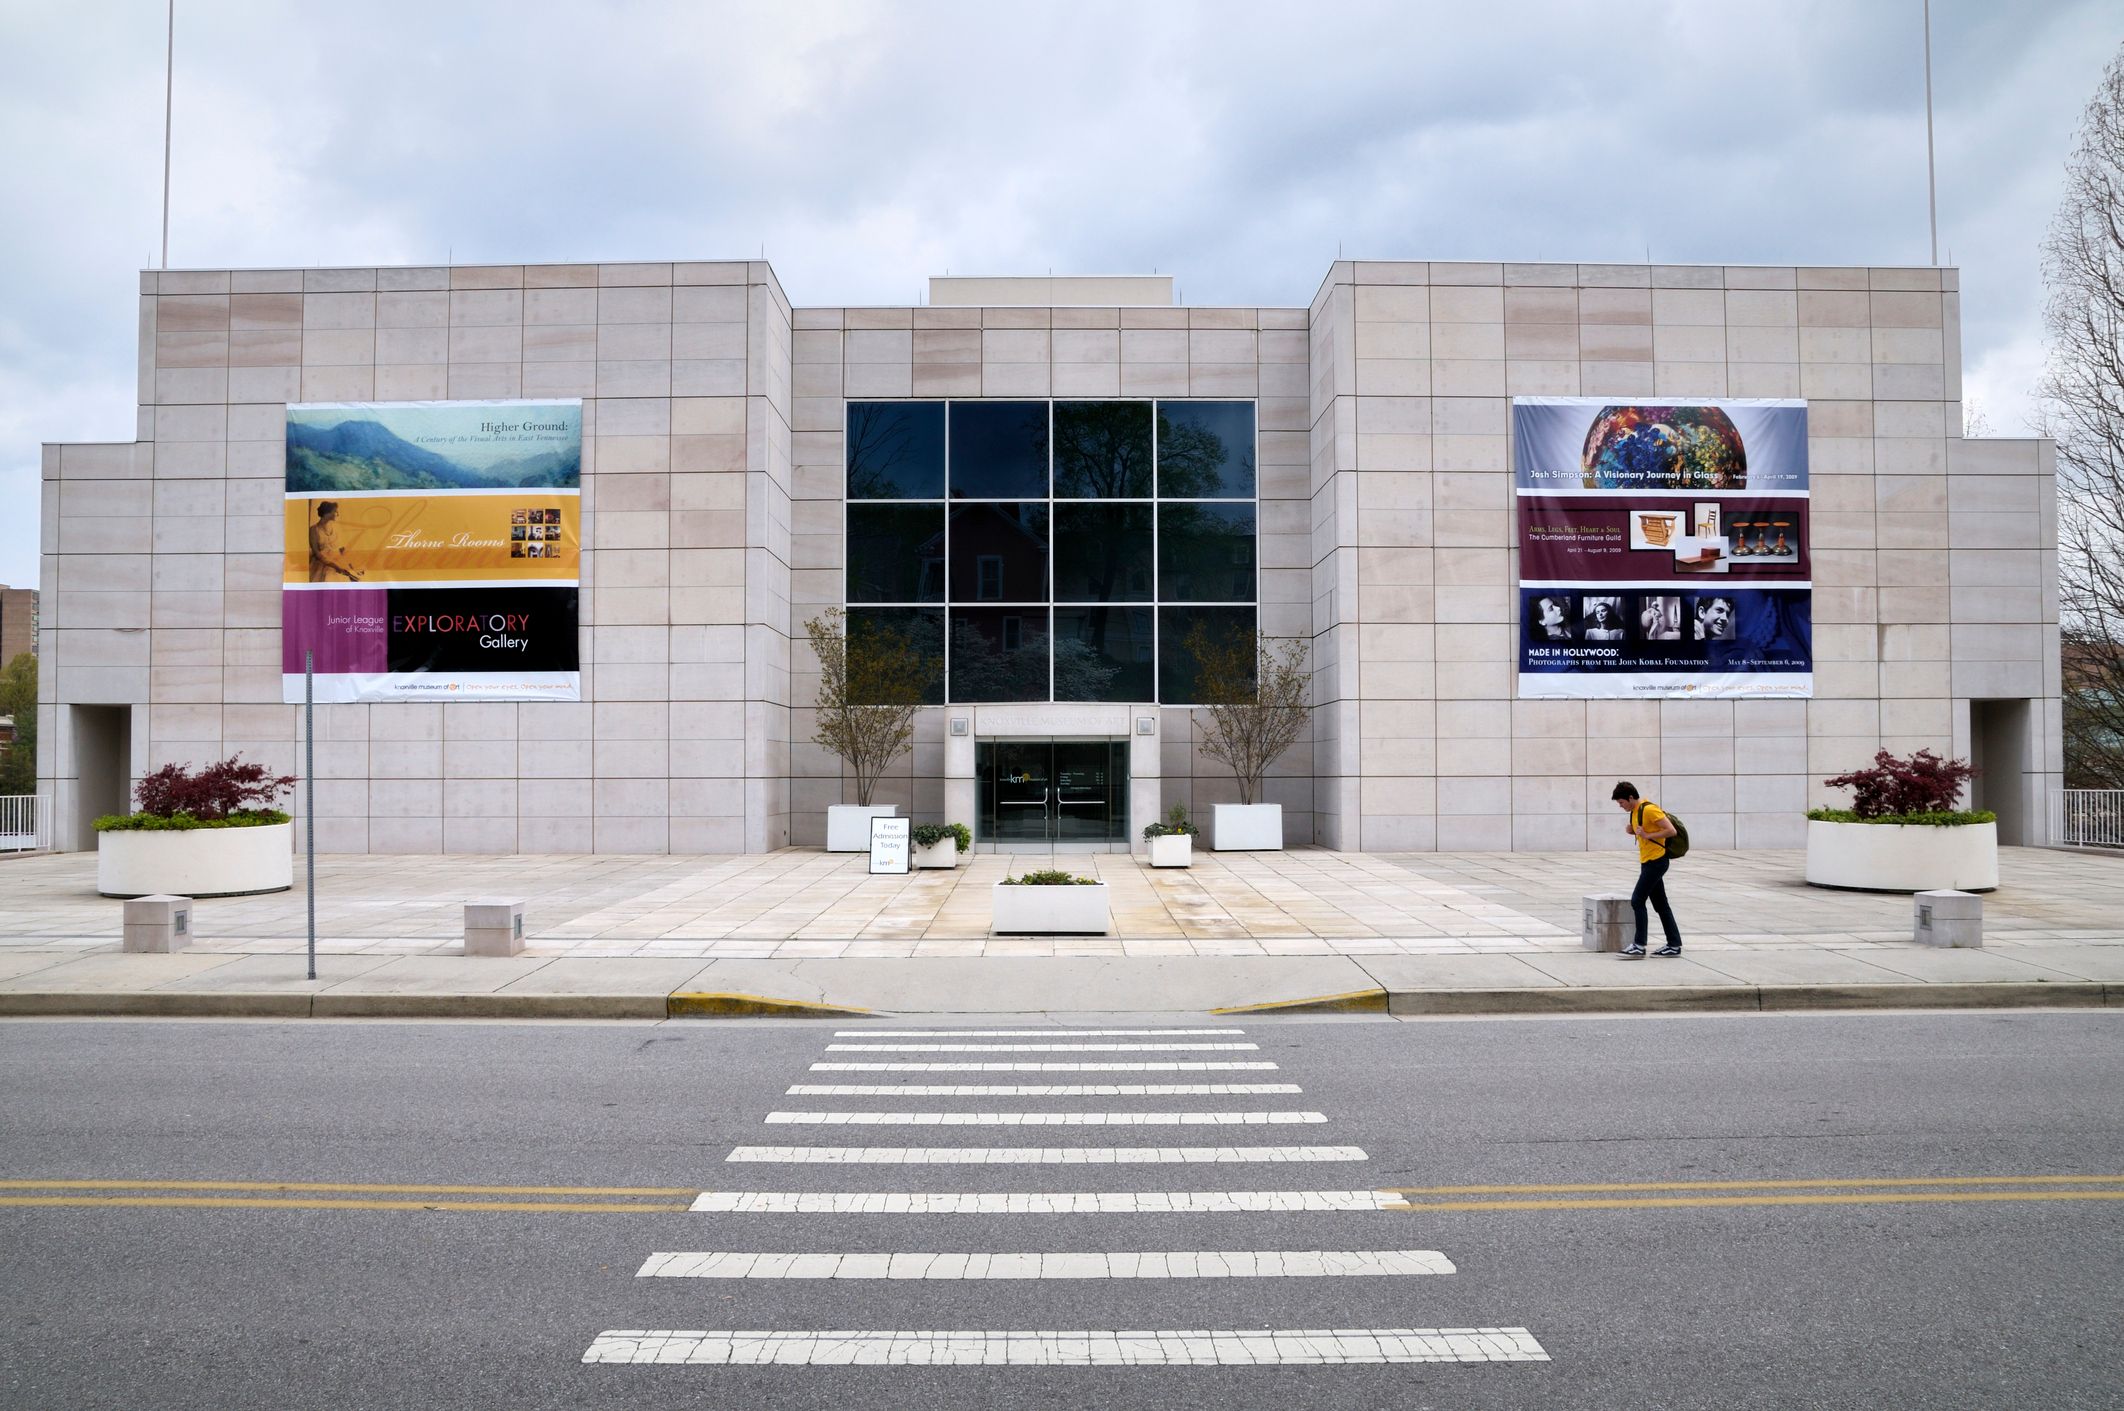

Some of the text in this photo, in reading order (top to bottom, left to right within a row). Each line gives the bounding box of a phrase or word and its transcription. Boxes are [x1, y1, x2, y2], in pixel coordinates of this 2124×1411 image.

[481, 421, 568, 434] Higher Ground:
[449, 436, 456, 444] of
[1530, 470, 1550, 479] Josh
[1551, 470, 1592, 480] Simpson:
[1603, 470, 1644, 480] Visionary
[1646, 470, 1681, 480] Journey
[1683, 470, 1692, 479] in
[1694, 471, 1718, 479] Glass
[1606, 525, 1621, 533] SOUL
[386, 528, 506, 549] Thorne Rooms
[328, 615, 384, 627] Junior League
[393, 614, 529, 632] EXPLORATORY
[354, 625, 384, 633] Knoxville
[479, 634, 528, 652] Gallery
[1528, 648, 1619, 657] MADE IN HOLLYWOOD:
[1528, 658, 1579, 666] PHOTOGRAPHS
[1619, 658, 1637, 666] JOHN
[1639, 658, 1664, 666] KOBAL
[1665, 658, 1709, 666] FOUNDATION
[880, 842, 901, 850] Today
